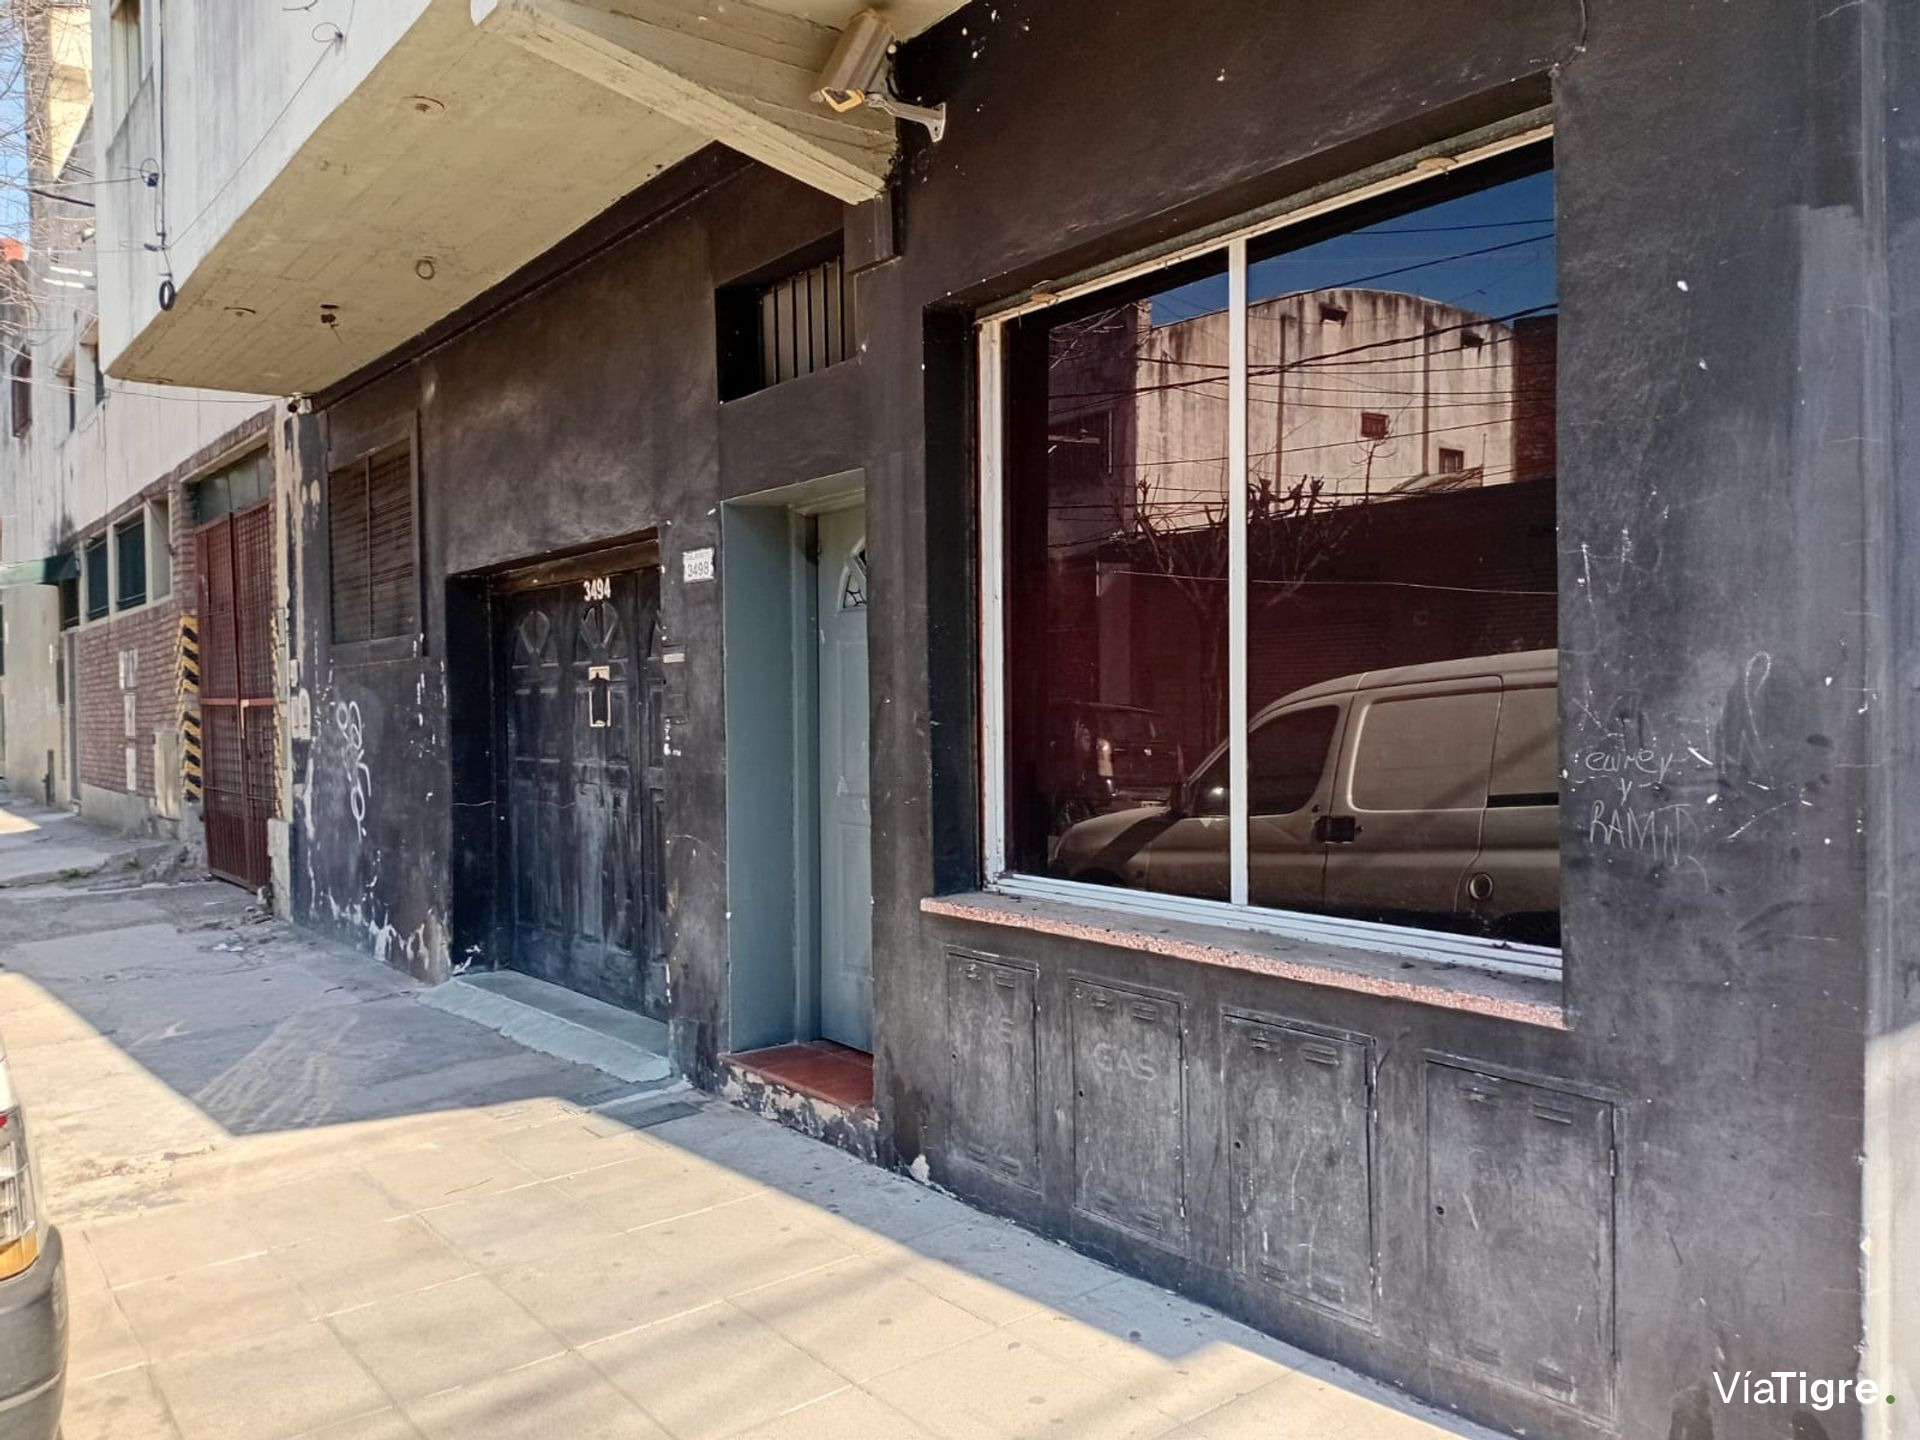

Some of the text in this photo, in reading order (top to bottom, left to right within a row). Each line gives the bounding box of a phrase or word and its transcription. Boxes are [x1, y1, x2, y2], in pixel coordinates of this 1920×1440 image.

[687, 560, 709, 577] 3498
[583, 577, 611, 601] 3494
[1093, 1042, 1158, 1081] GAS
